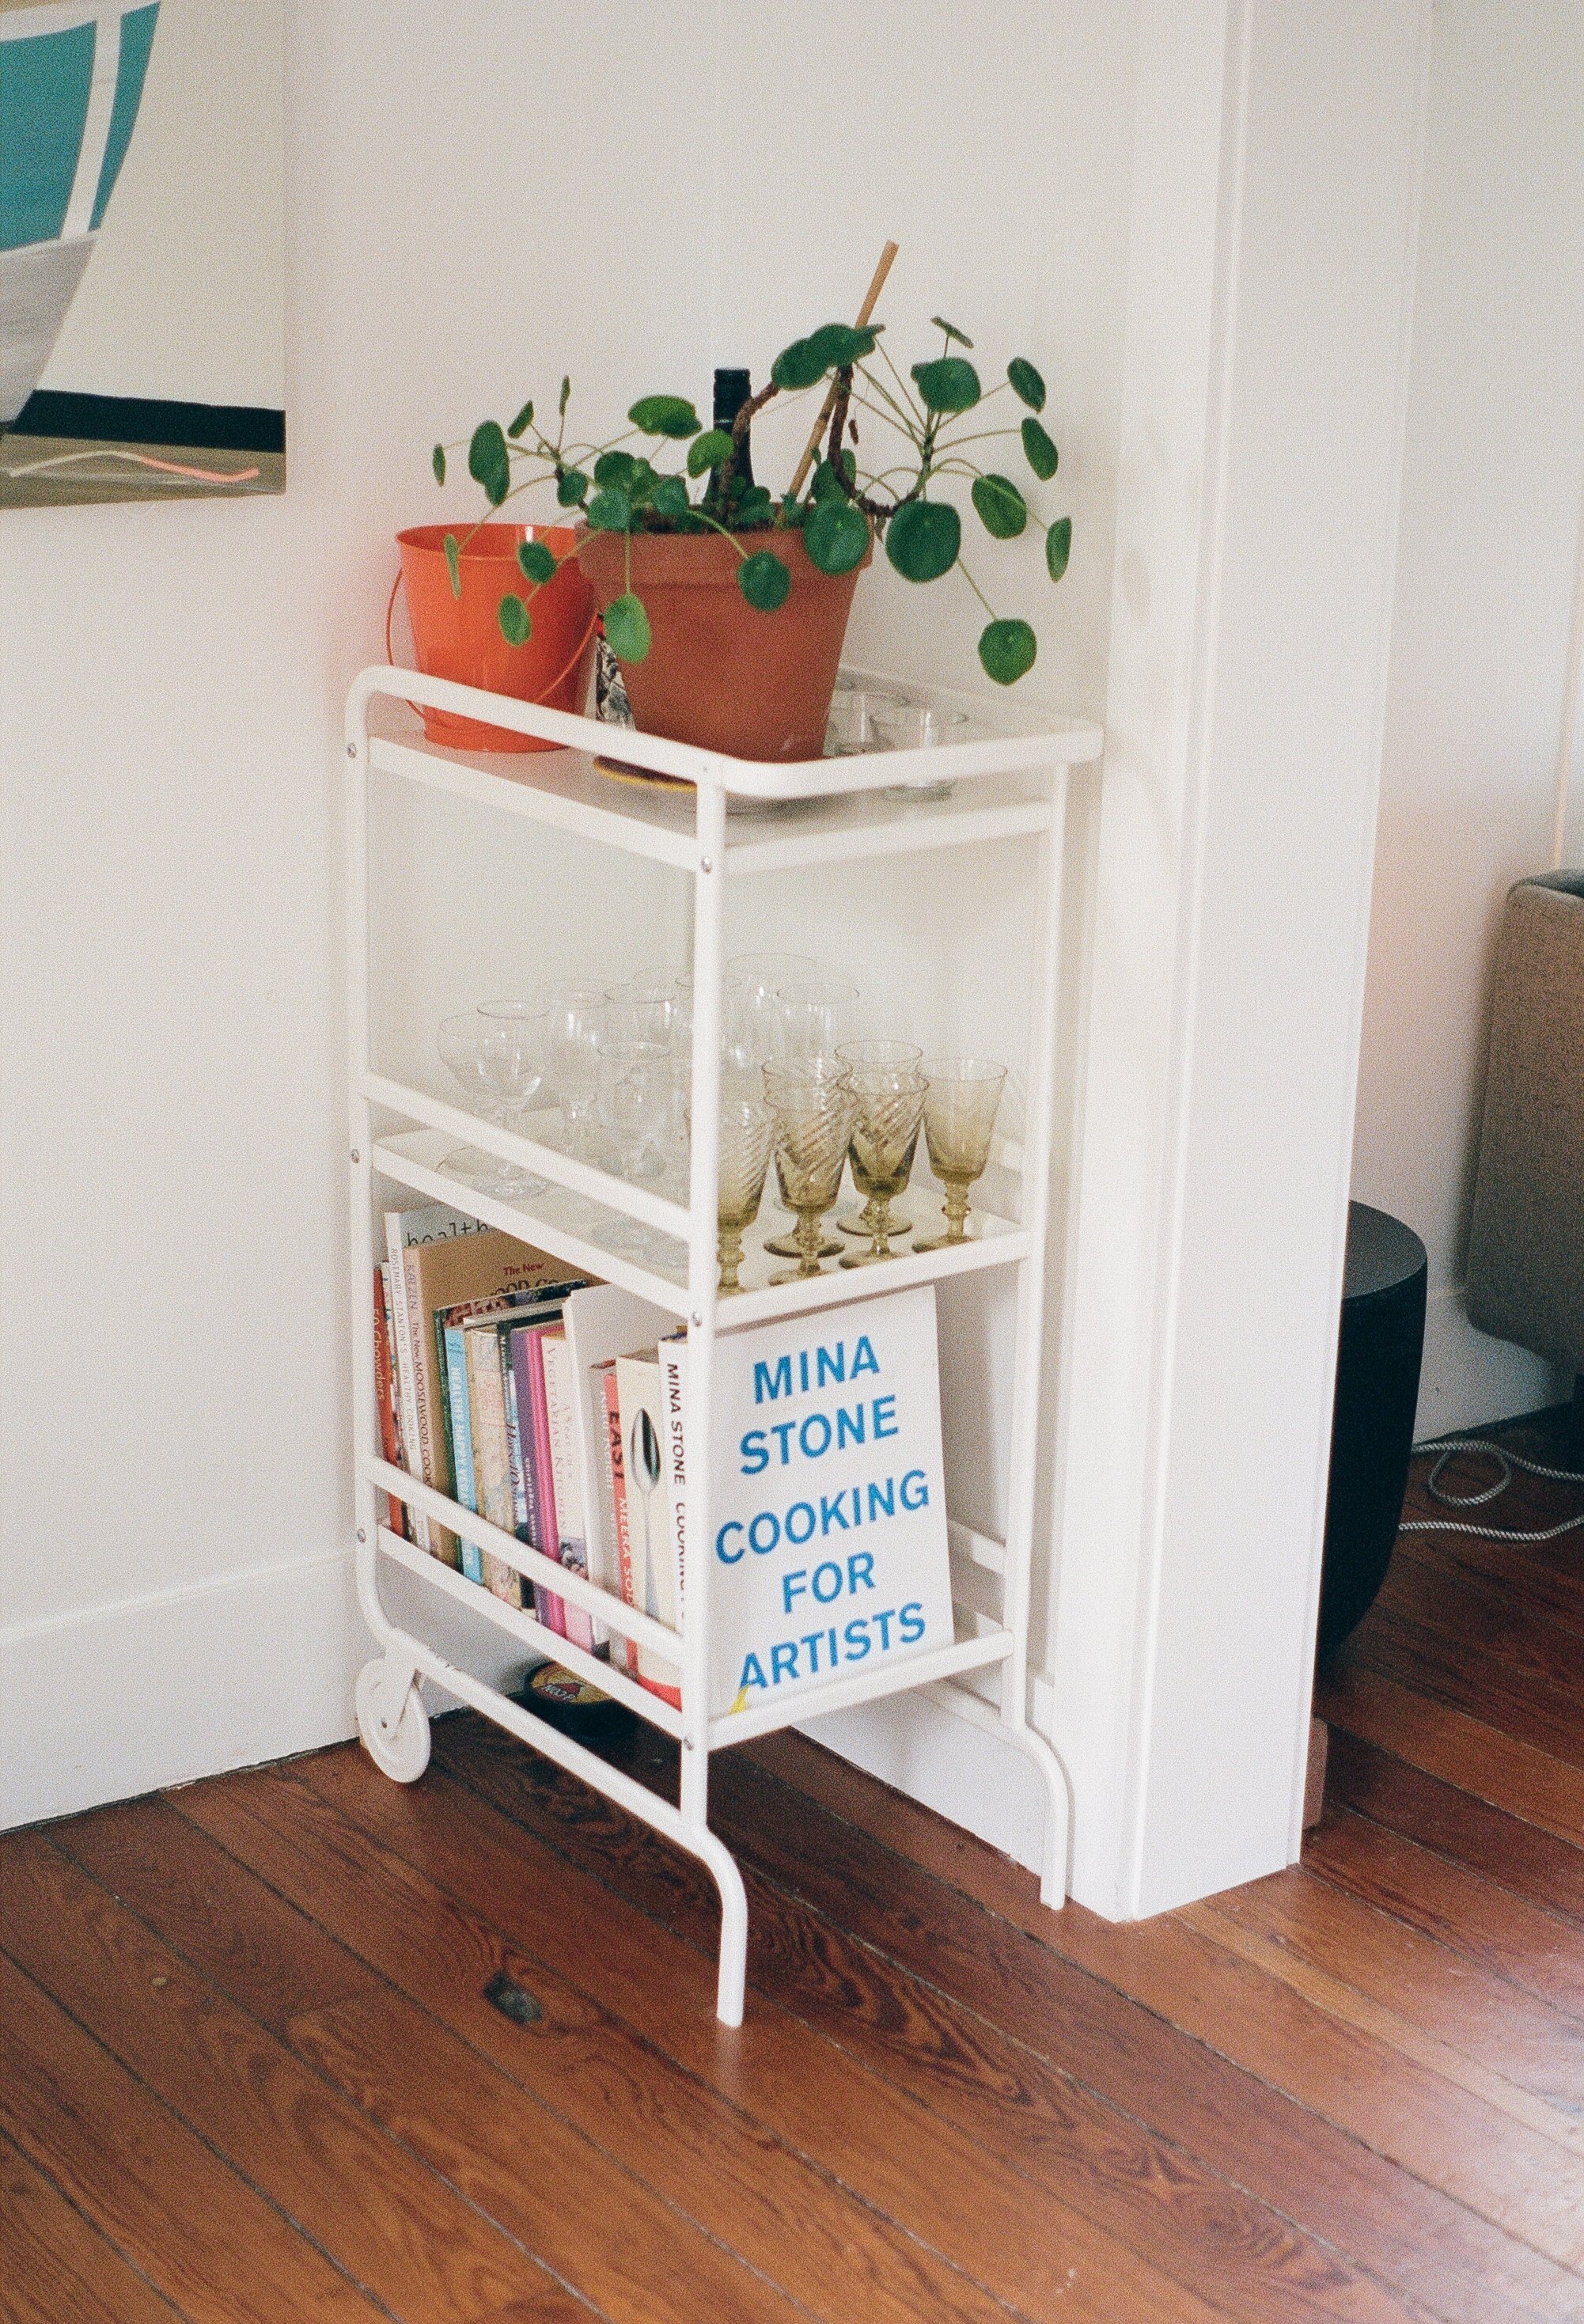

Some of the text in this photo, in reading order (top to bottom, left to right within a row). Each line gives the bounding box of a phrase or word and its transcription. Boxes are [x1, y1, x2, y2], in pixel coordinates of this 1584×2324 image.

[392, 1249, 401, 1295] ROSEMARY
[503, 1263, 544, 1276] The New
[396, 1300, 408, 1354] STANTON'S
[412, 1322, 421, 1336] The
[402, 1363, 412, 1403] HEALTHY
[451, 1367, 465, 1419] HEALTHY
[667, 1363, 681, 1413] MINA
[753, 1335, 880, 1405] MINA
[414, 1361, 429, 1445] MOOSEWOOD
[455, 1426, 468, 1464] HAPPY
[548, 1348, 566, 1530] VEGETARIAN KITCHEN
[608, 1411, 624, 1480] EAST
[671, 1421, 686, 1485] STONE
[740, 1394, 899, 1475] STONE
[619, 1497, 631, 1559] MEERA
[715, 1469, 930, 1564] COOKING
[782, 1552, 876, 1614] FOR
[739, 1602, 926, 1689] ARTISTS
